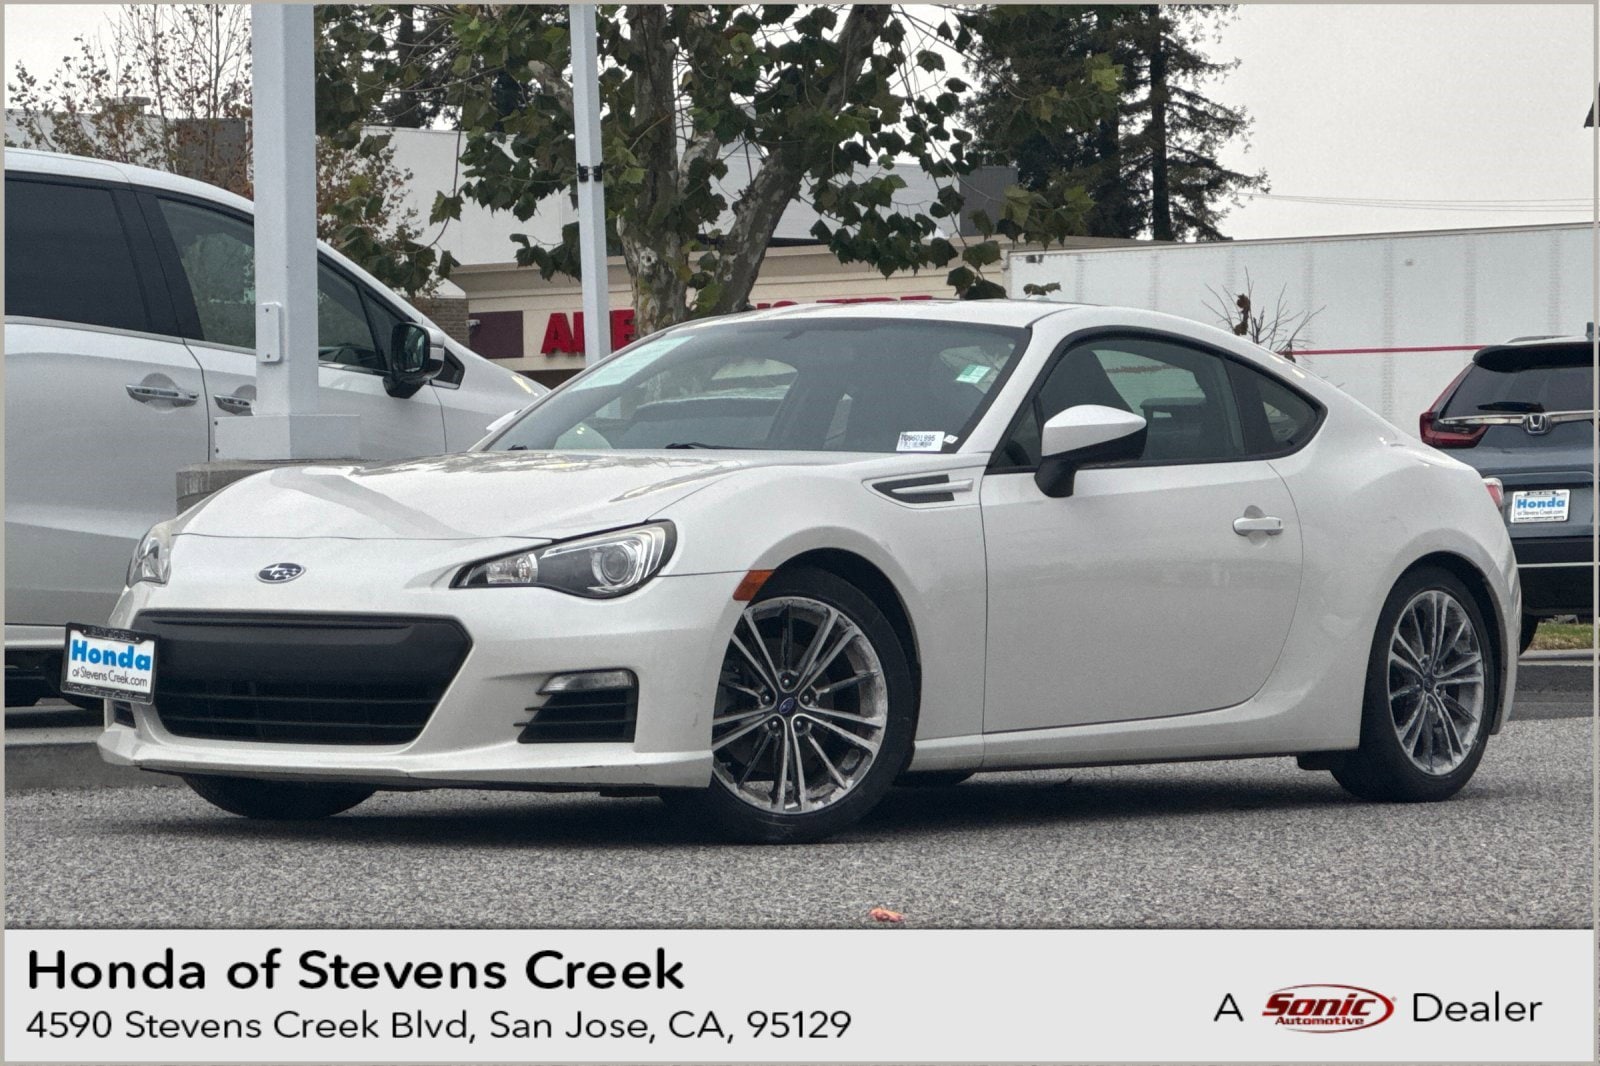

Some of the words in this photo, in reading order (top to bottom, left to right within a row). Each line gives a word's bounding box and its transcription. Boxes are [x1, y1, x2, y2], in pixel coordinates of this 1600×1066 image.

[1517, 497, 1566, 508] Honda
[72, 639, 151, 671] Honda
[72, 667, 80, 677] of
[80, 666, 108, 681] Stevens
[108, 669, 148, 687] Creek.com
